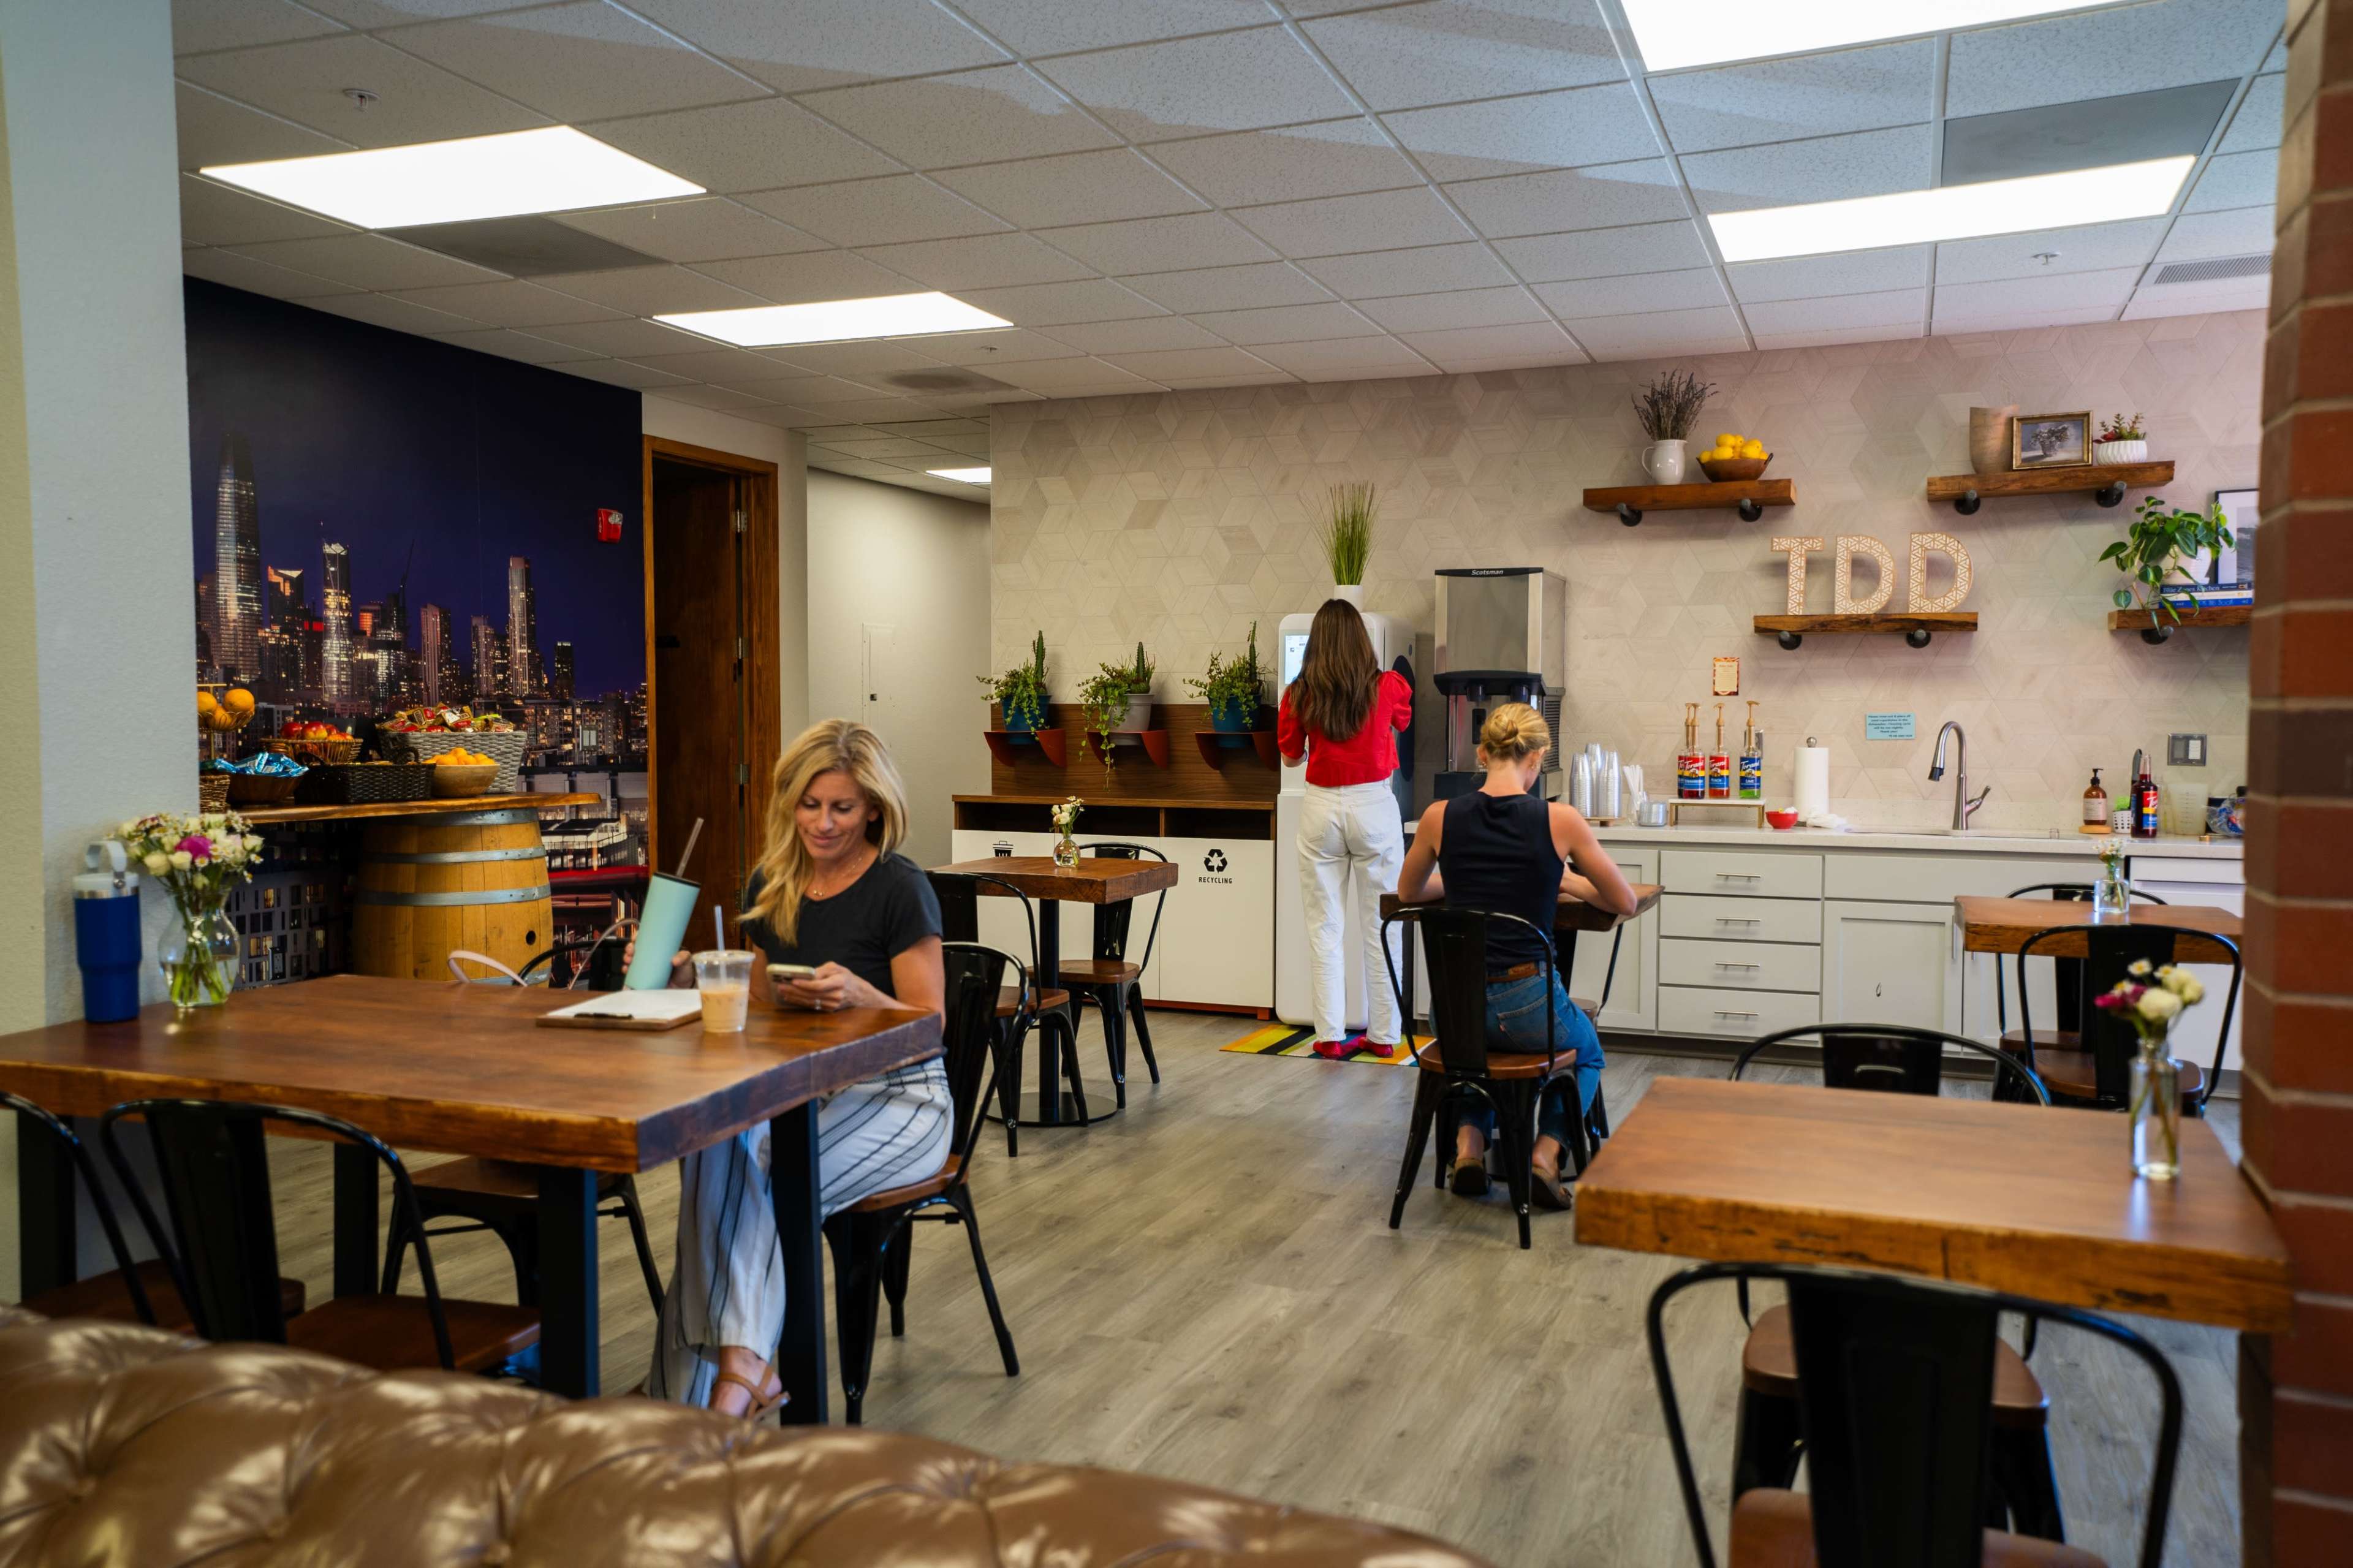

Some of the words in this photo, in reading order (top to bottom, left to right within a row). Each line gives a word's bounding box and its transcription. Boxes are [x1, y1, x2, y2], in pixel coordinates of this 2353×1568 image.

[1771, 532, 1973, 615] TDD
[1684, 760, 1704, 770] Torani
[1740, 760, 1760, 770] Torani
